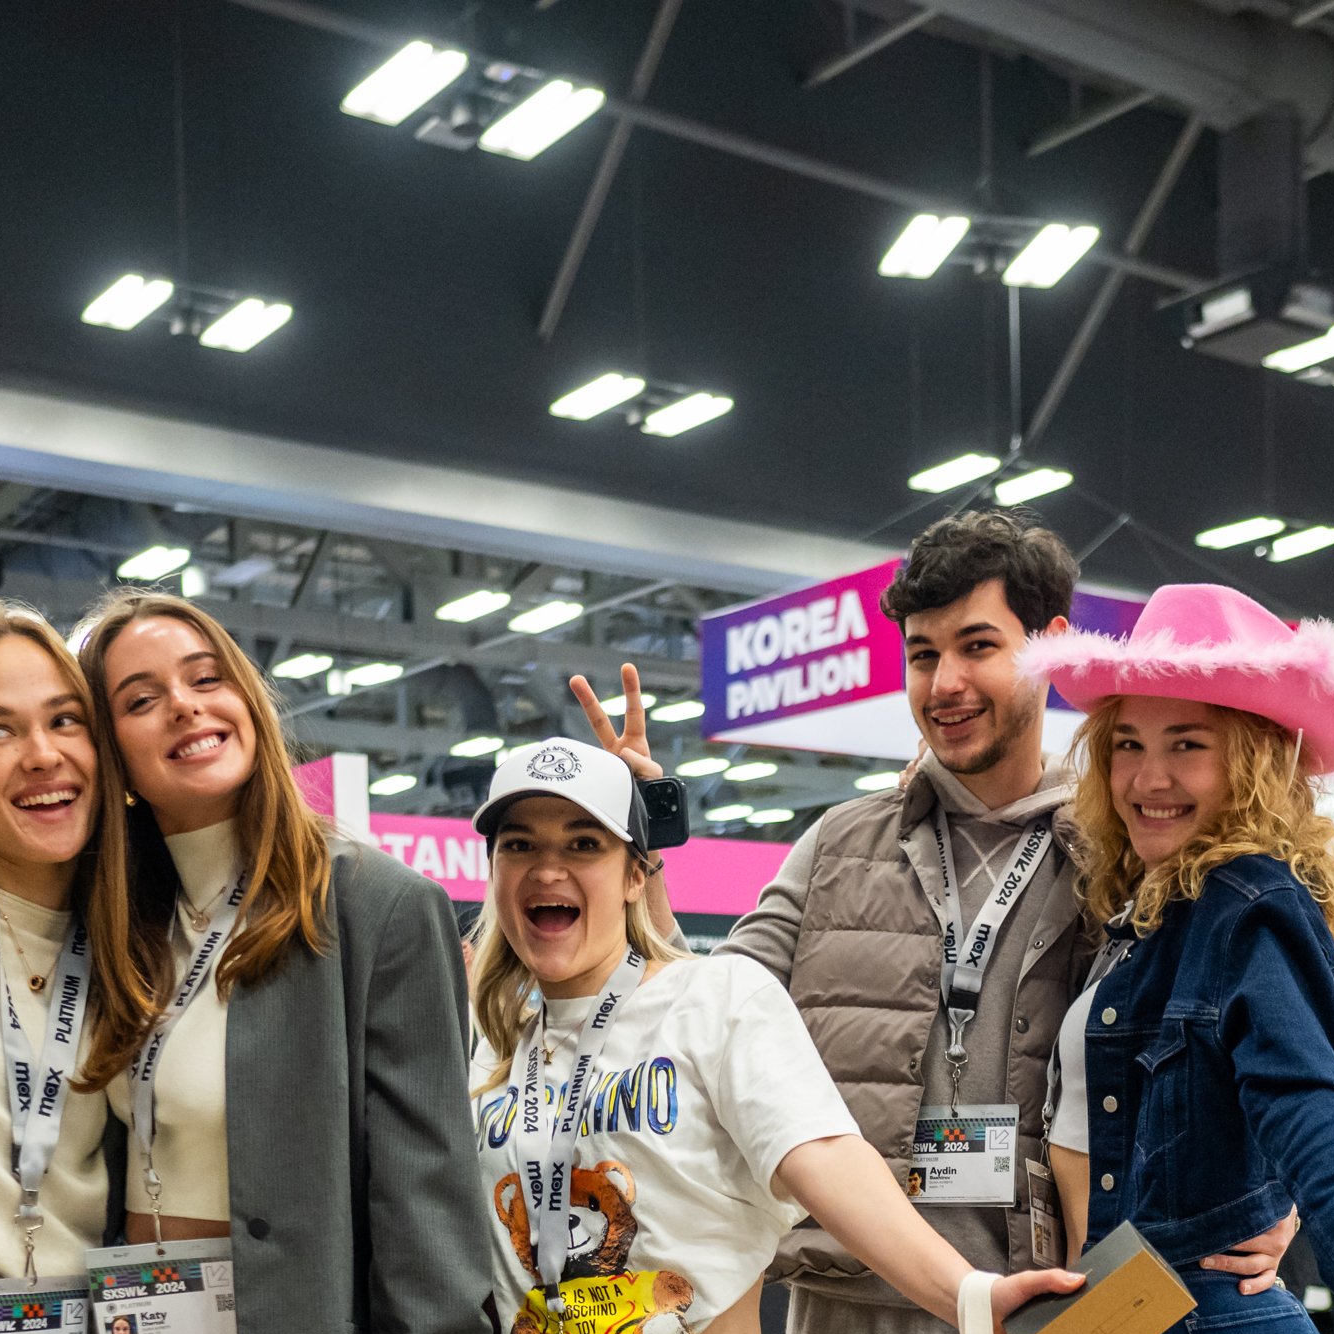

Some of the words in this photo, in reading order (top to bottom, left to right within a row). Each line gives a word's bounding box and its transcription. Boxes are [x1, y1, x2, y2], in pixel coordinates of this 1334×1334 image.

[726, 589, 870, 675] KOREA
[726, 646, 871, 720] PAVILION
[542, 754, 555, 763] D
[554, 763, 566, 774] S
[1021, 823, 1047, 865] SXSW
[995, 871, 1021, 906] 2024
[945, 921, 958, 964] max
[966, 923, 991, 967] max
[174, 931, 222, 1007] PLATINUM
[54, 974, 81, 1044] PLATINUM
[591, 992, 622, 1029] max
[141, 1032, 164, 1081] max
[525, 1046, 540, 1086] SXSW
[15, 1061, 31, 1113] max
[38, 1067, 65, 1117] max
[561, 1054, 592, 1133] PLATINUM
[524, 1096, 539, 1134] 2024
[943, 1142, 970, 1152] 2024
[527, 1160, 542, 1210] max
[548, 1161, 565, 1211] max
[929, 1166, 957, 1178] Aydin
[102, 1286, 136, 1300] SXSW
[155, 1281, 187, 1294] 2024
[573, 1288, 586, 1304] IS
[588, 1285, 611, 1302] NOT
[614, 1284, 624, 1297] A
[22, 1318, 48, 1331] 2024
[140, 1311, 168, 1323] Katy
